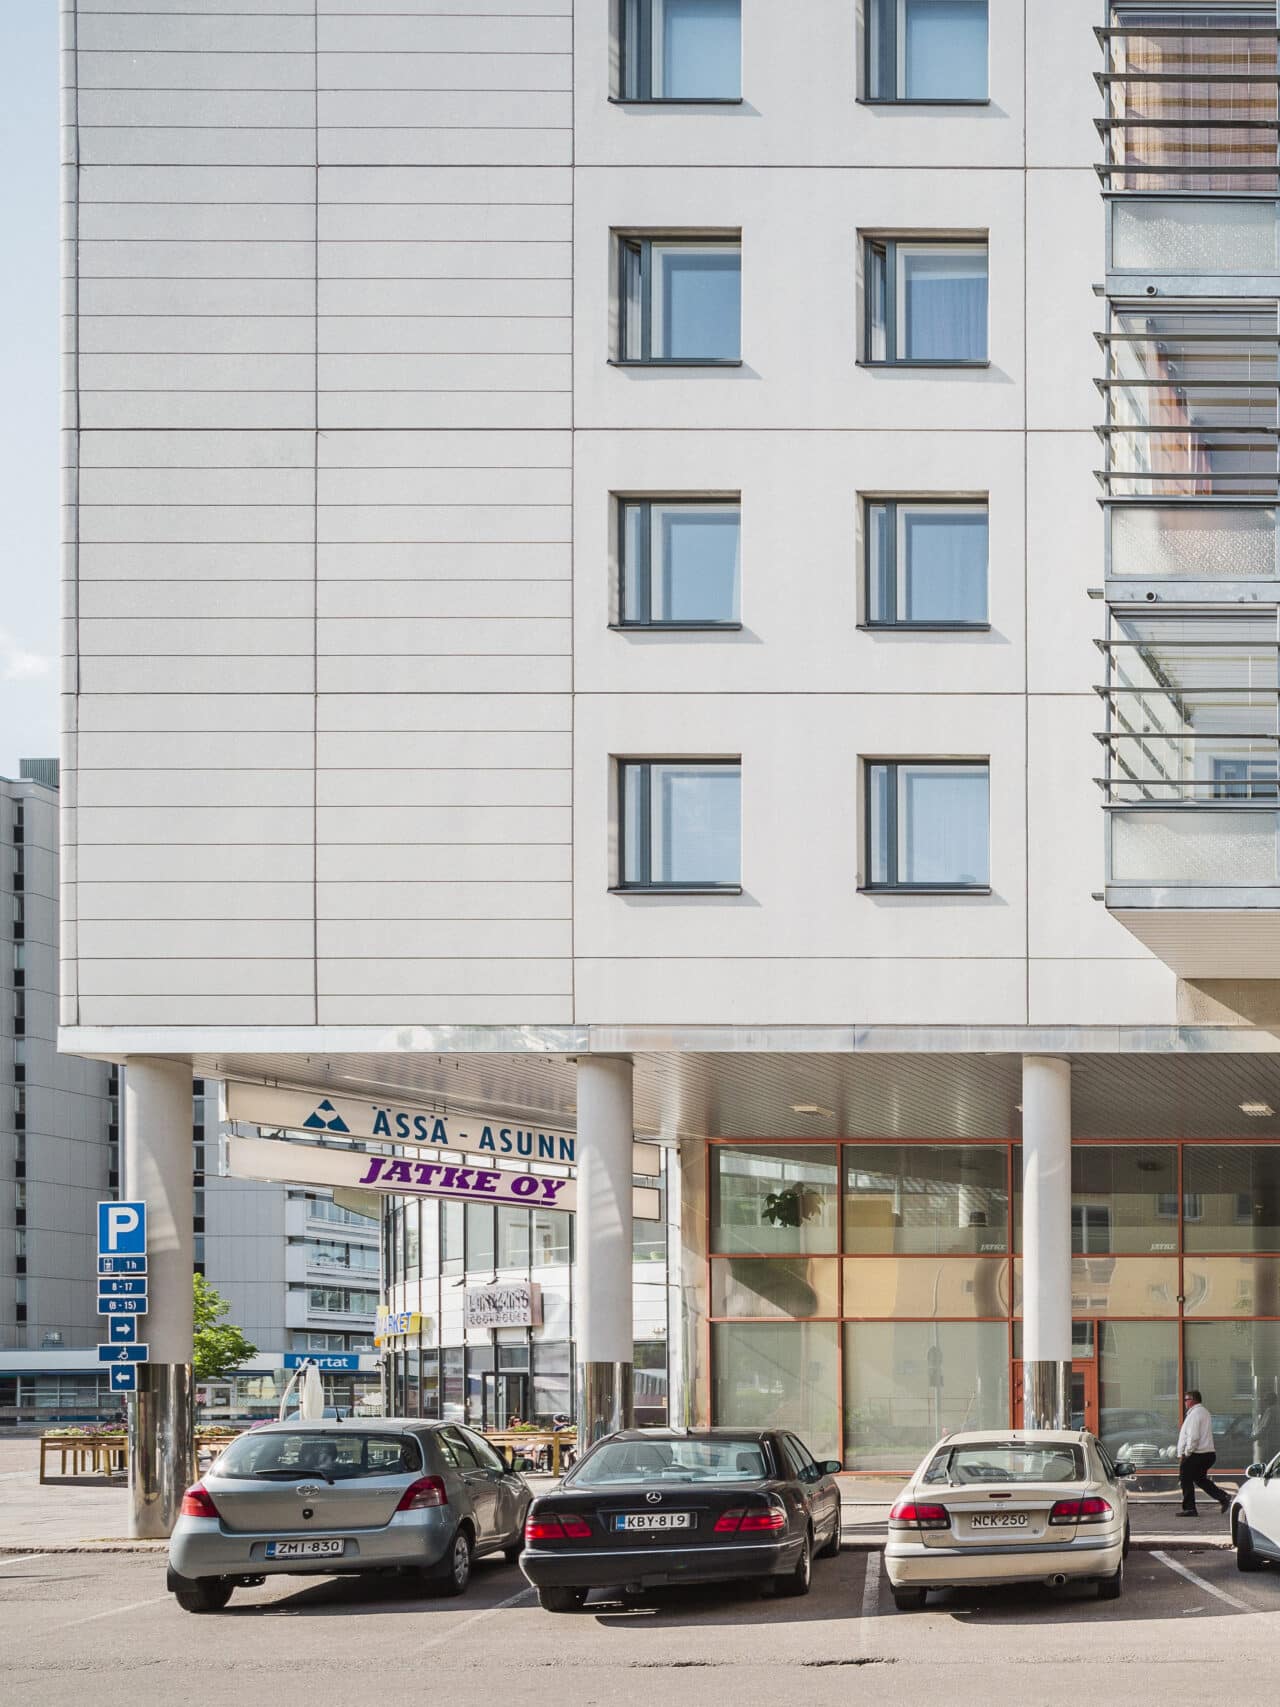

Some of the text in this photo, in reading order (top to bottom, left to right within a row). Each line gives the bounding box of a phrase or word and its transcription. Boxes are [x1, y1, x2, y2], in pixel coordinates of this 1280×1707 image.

[372, 1106, 449, 1145] ÄSSÄ
[479, 1126, 575, 1162] ASUNN
[359, 1157, 566, 1199] JATKE OY
[108, 1207, 139, 1250] P
[111, 1282, 117, 1291] 8
[125, 1282, 133, 1291] 17
[627, 1515, 686, 1528] KBY-819
[973, 1514, 1026, 1527] NCK-250
[278, 1541, 339, 1554] ZMI-830
